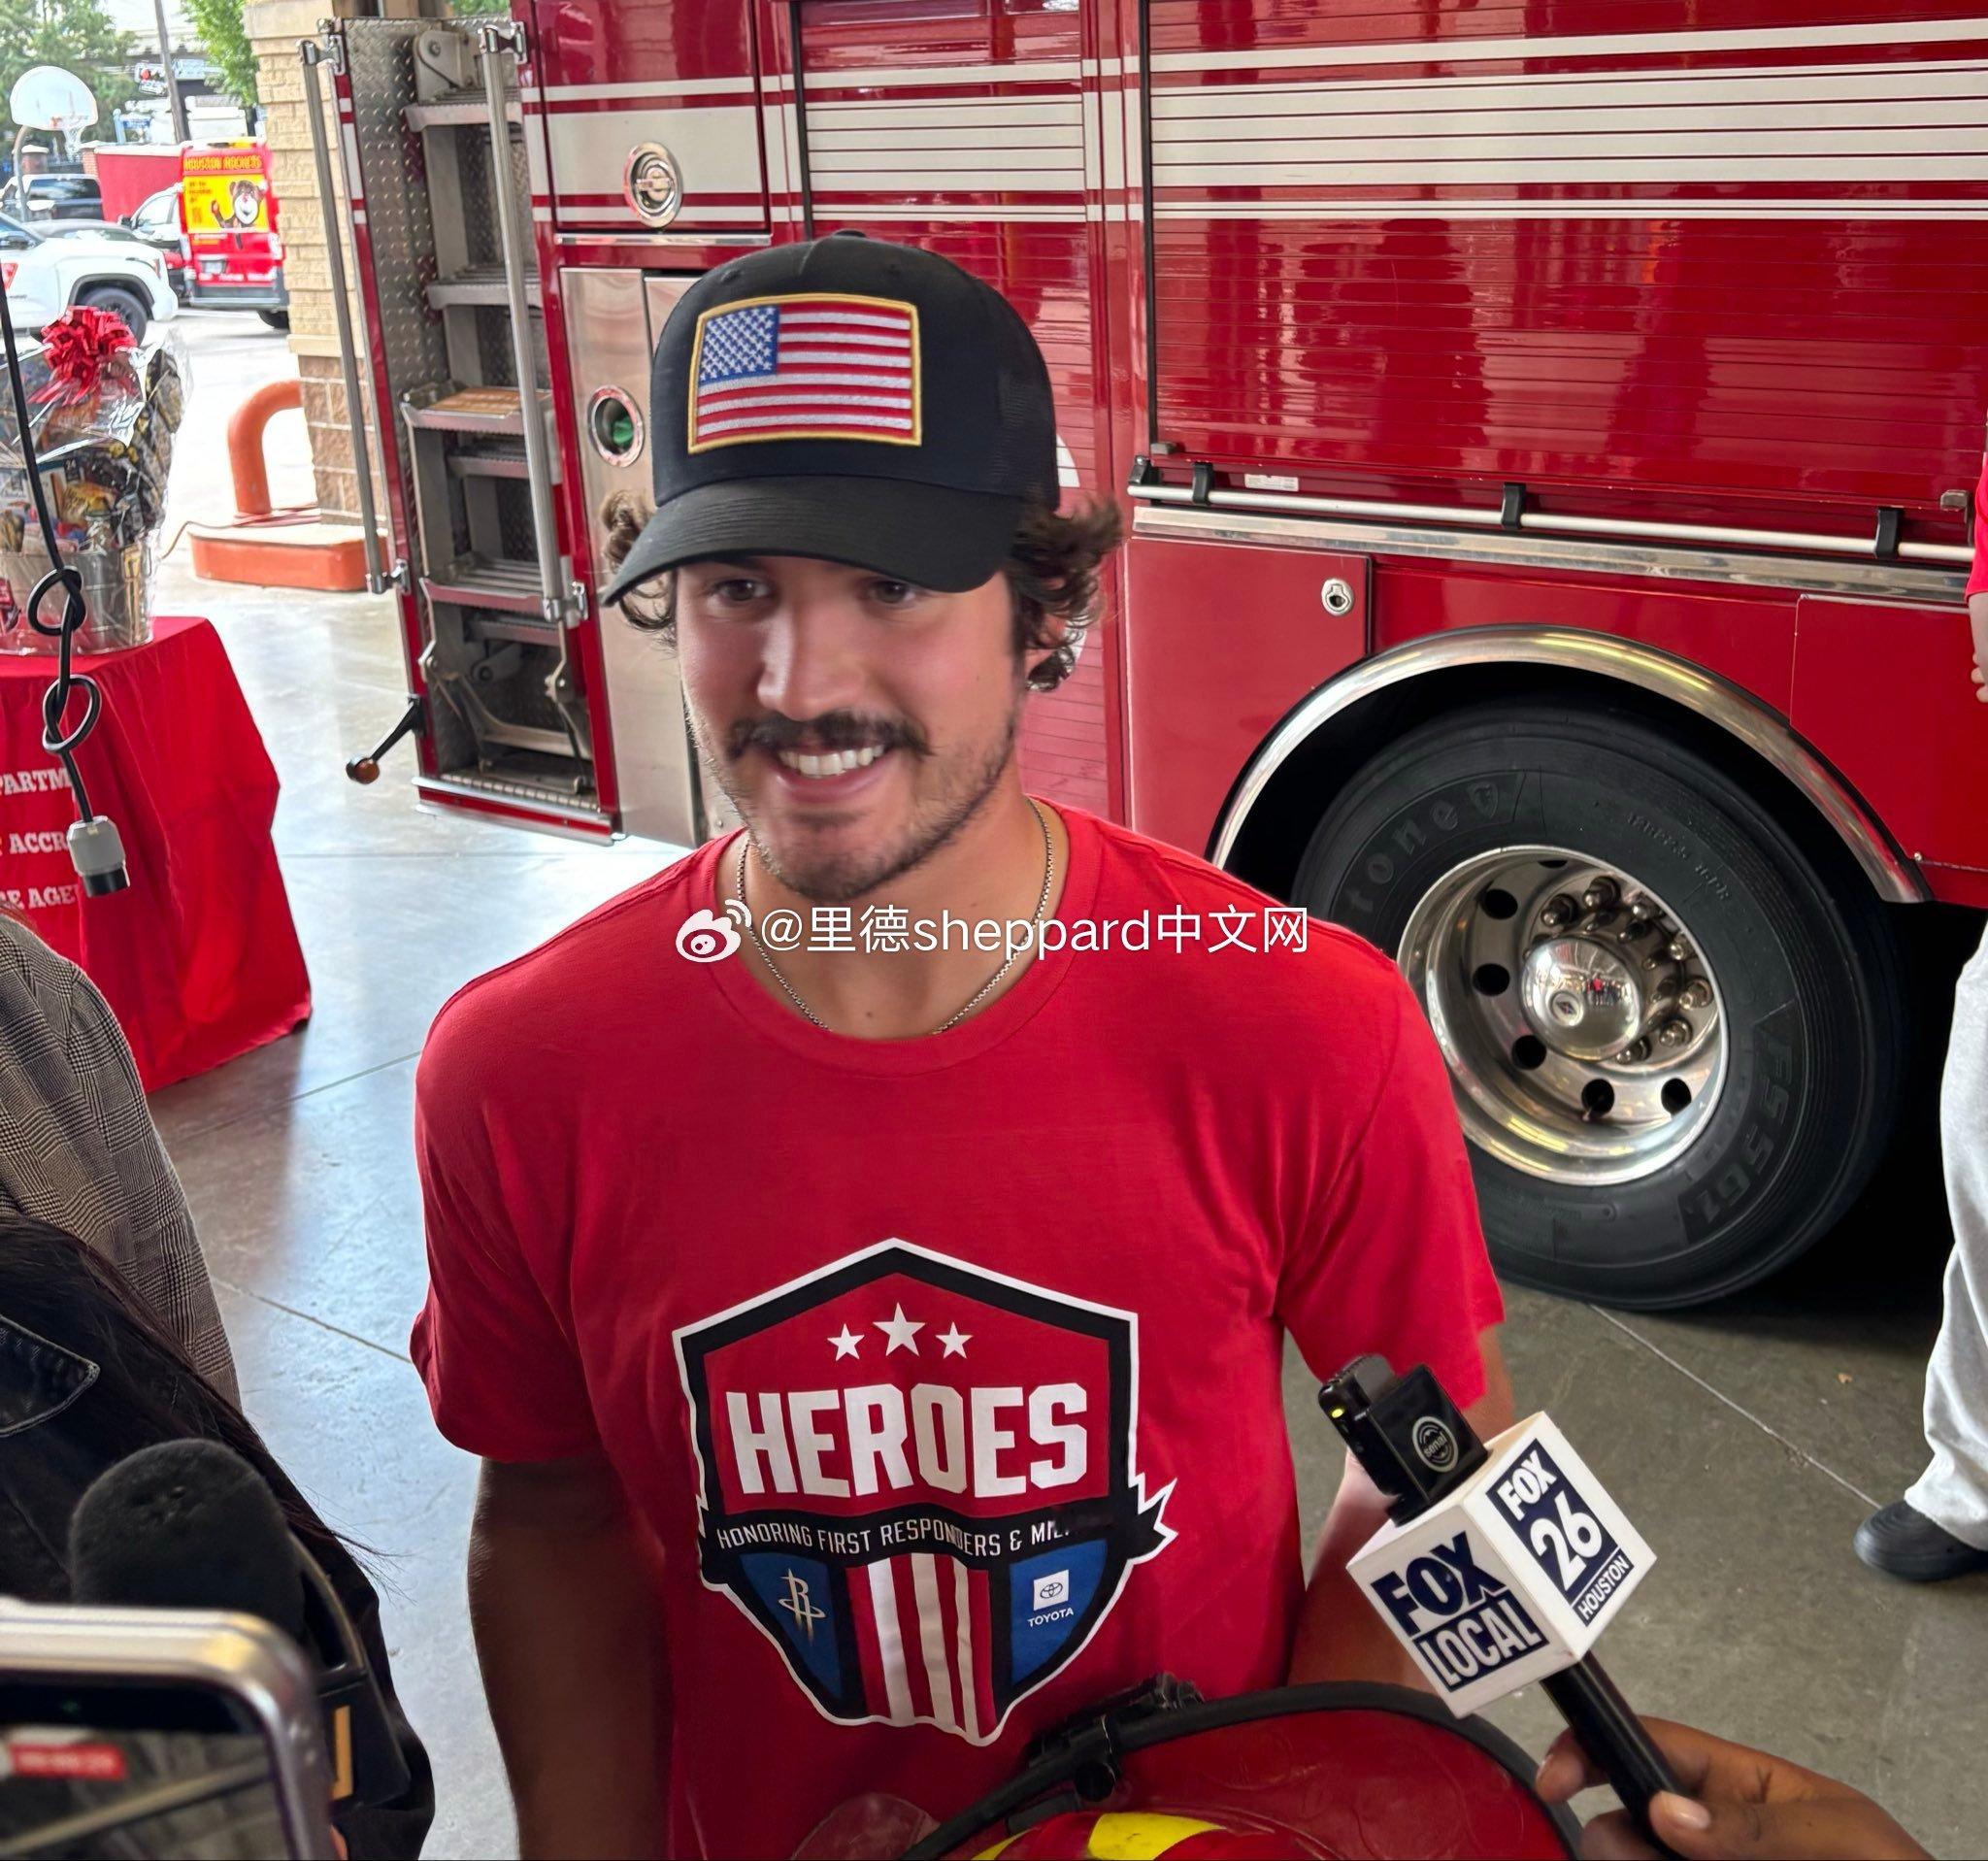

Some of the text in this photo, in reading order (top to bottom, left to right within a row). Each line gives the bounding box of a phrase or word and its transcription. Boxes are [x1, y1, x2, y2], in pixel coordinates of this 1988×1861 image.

[726, 1382, 1087, 1498] HEROES
[1496, 1450, 1557, 1521] FOX
[716, 1522, 813, 1550] HONORING
[817, 1529, 872, 1554] FIRST
[880, 1518, 1002, 1556] RESPONDERS
[1010, 1529, 1023, 1551] &
[1530, 1490, 1603, 1591] 26
[1027, 1607, 1075, 1628] TOYOTA
[1371, 1531, 1507, 1637] FOX
[1577, 1556, 1631, 1621] HOUSTON
[1419, 1598, 1544, 1685] LOCAL
